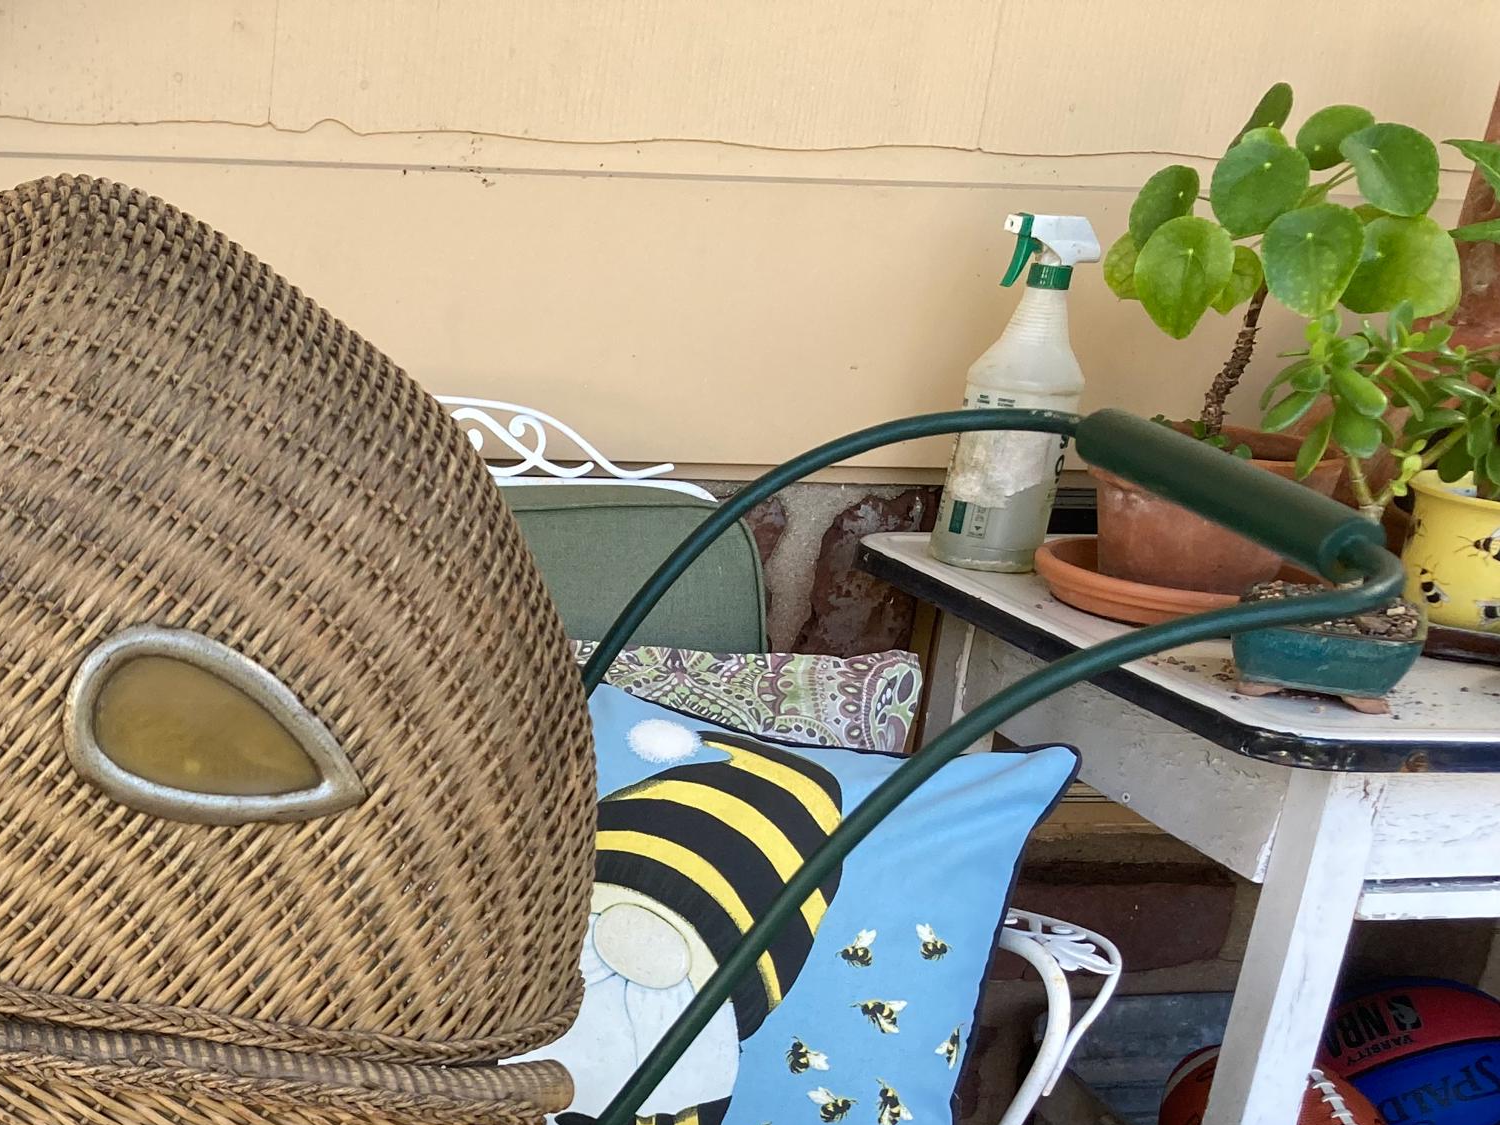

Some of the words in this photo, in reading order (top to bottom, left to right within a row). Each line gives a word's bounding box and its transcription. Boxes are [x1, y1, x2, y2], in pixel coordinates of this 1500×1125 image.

[1328, 1004, 1389, 1057] NBA
[1346, 1036, 1413, 1066] VARSITY
[1378, 1057, 1500, 1124] SPALD
